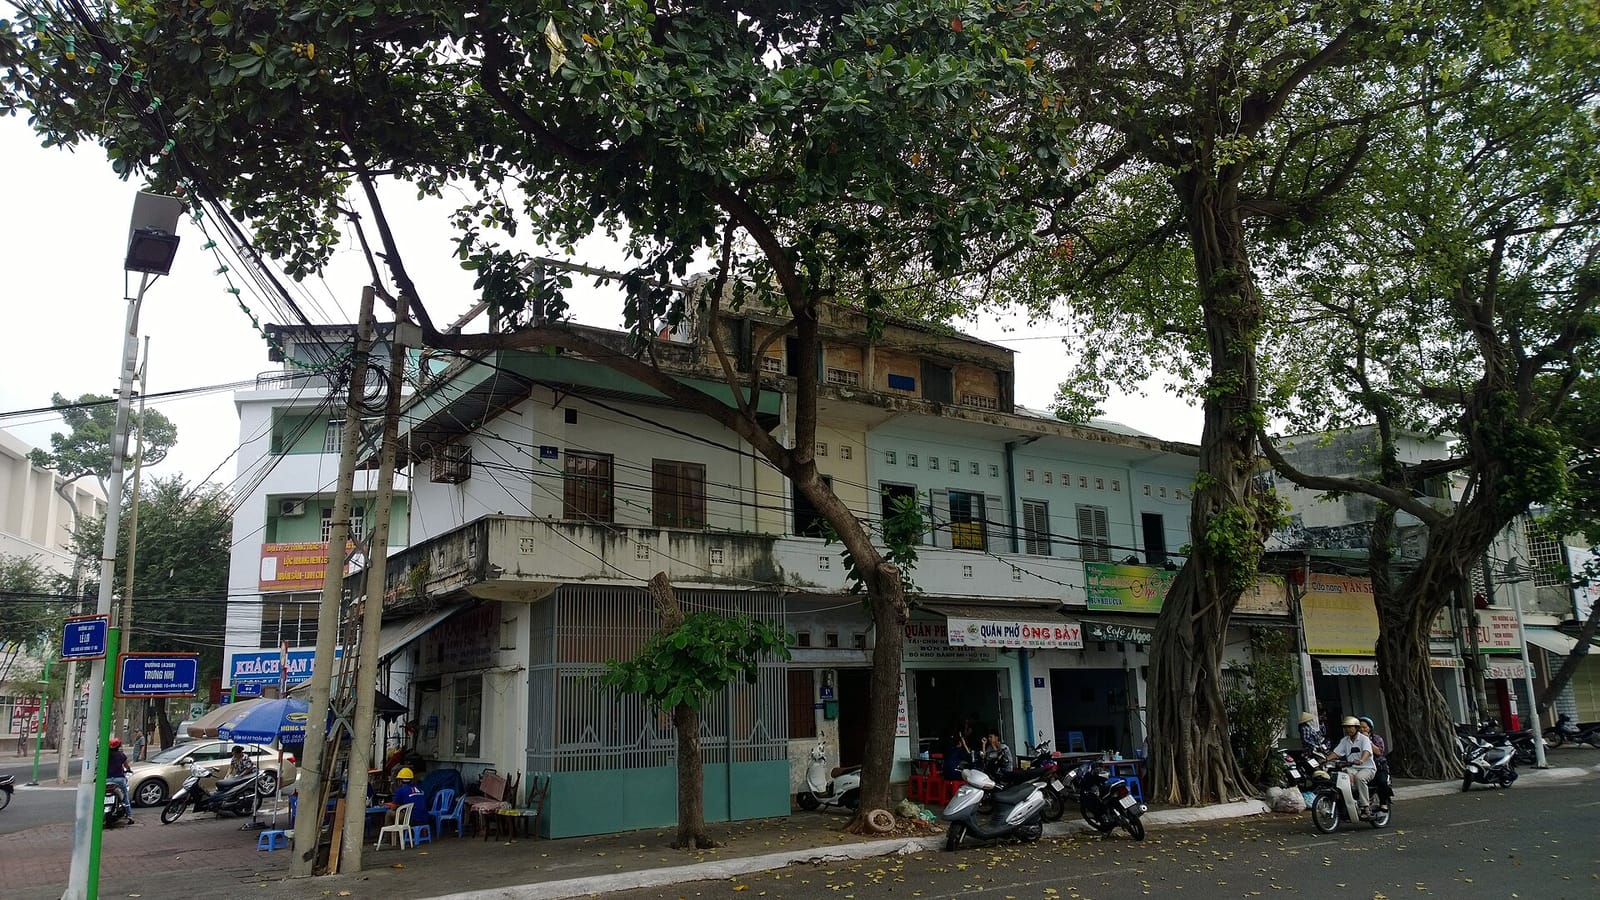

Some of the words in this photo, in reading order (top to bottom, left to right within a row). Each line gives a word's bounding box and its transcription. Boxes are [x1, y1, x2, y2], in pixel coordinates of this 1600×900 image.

[934, 625, 947, 637] PH
[980, 622, 1002, 638] QUÁN
[1004, 622, 1020, 638] PHỞ
[1022, 625, 1051, 639] ÔNG
[1054, 625, 1079, 640] BẢY
[235, 657, 280, 675] KHÁCH
